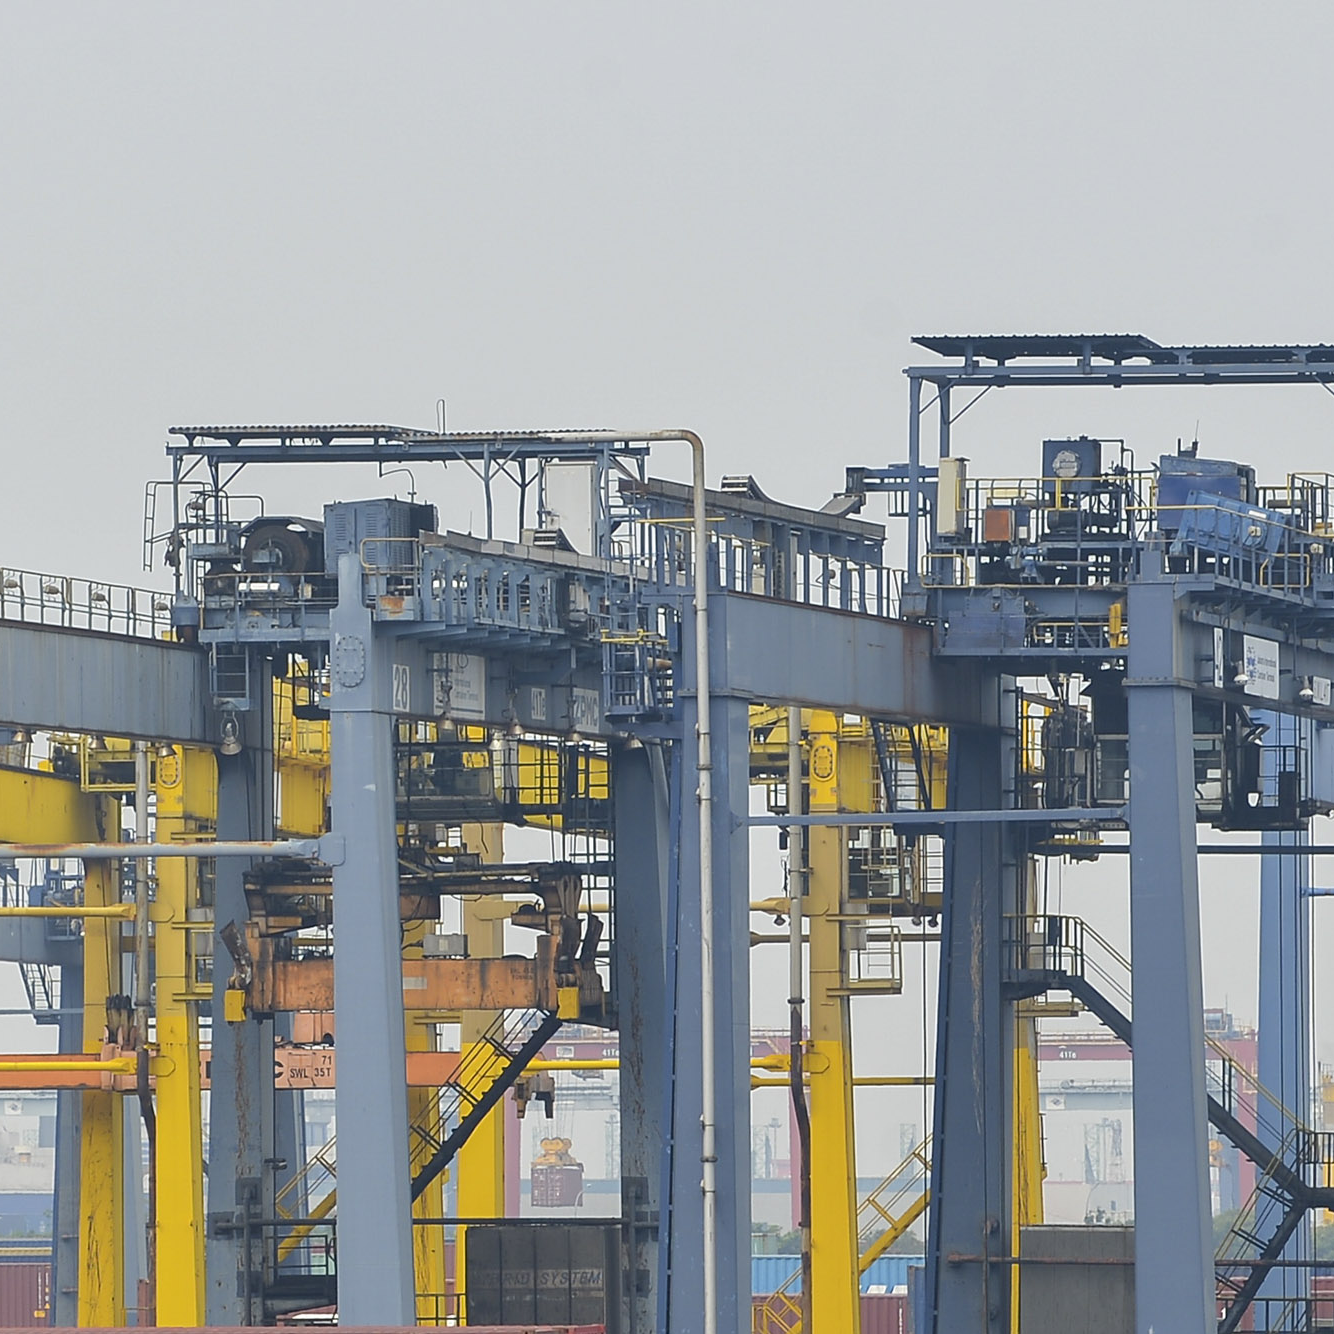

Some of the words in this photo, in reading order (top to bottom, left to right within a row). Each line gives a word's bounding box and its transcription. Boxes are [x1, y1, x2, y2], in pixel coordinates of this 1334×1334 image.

[394, 667, 407, 711] 28
[322, 1056, 331, 1065] 71
[288, 1069, 308, 1080] SWL
[311, 1068, 331, 1079] 35T
